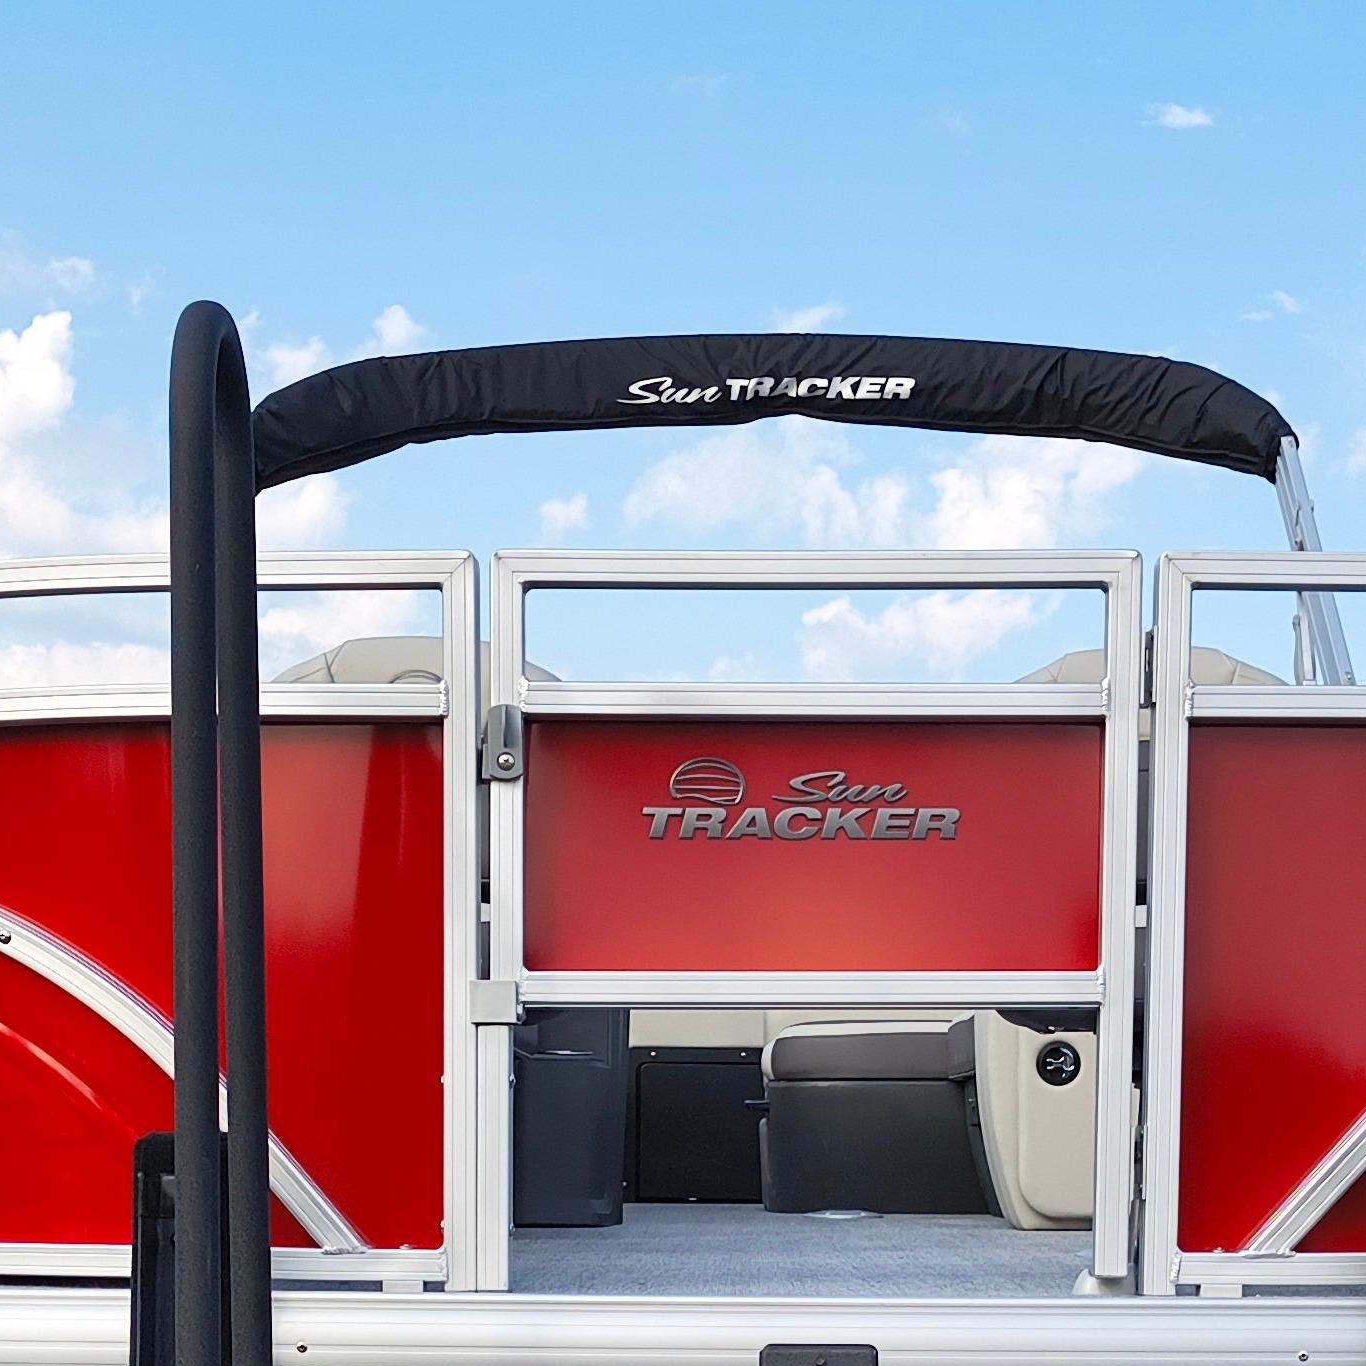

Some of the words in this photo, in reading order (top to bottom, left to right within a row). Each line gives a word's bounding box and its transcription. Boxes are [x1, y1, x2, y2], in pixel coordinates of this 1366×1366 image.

[617, 376, 722, 404] Sun
[726, 376, 916, 401] TRACKER
[772, 771, 907, 803] Sun
[642, 806, 961, 840] TRACKER
